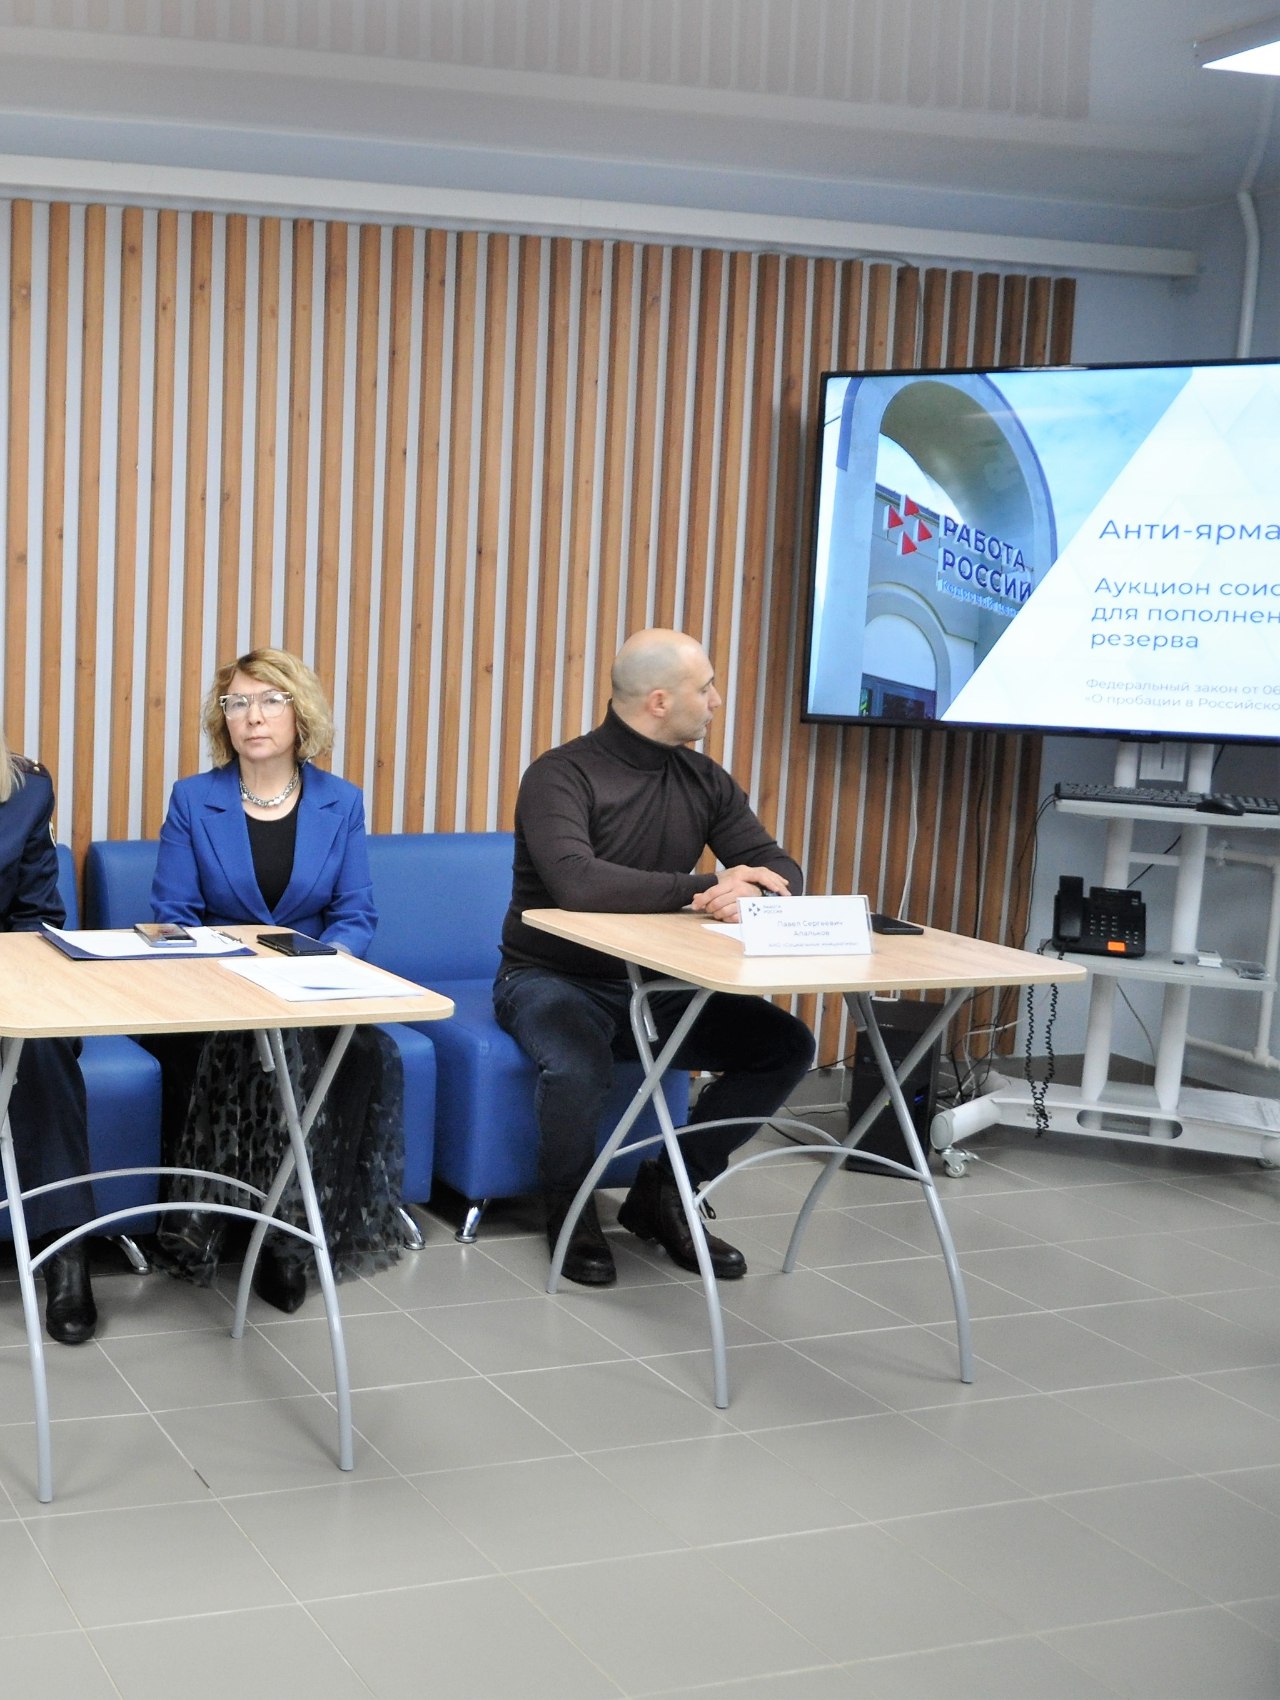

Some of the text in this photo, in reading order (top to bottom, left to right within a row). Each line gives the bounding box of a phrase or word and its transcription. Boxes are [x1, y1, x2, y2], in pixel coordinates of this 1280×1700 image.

[1098, 519, 1280, 546] Анти-ярма
[943, 514, 1026, 573] РАБОТА
[942, 547, 1032, 602] РОССИИ
[1094, 577, 1211, 598] Аукцион
[1091, 607, 1280, 624] для пополнен
[1091, 633, 1199, 651] резерва
[1086, 678, 1190, 692] Федеральный
[1194, 684, 1238, 694] закон
[1242, 686, 1258, 695] от
[1106, 694, 1182, 708] пробации
[1185, 699, 1194, 708] в
